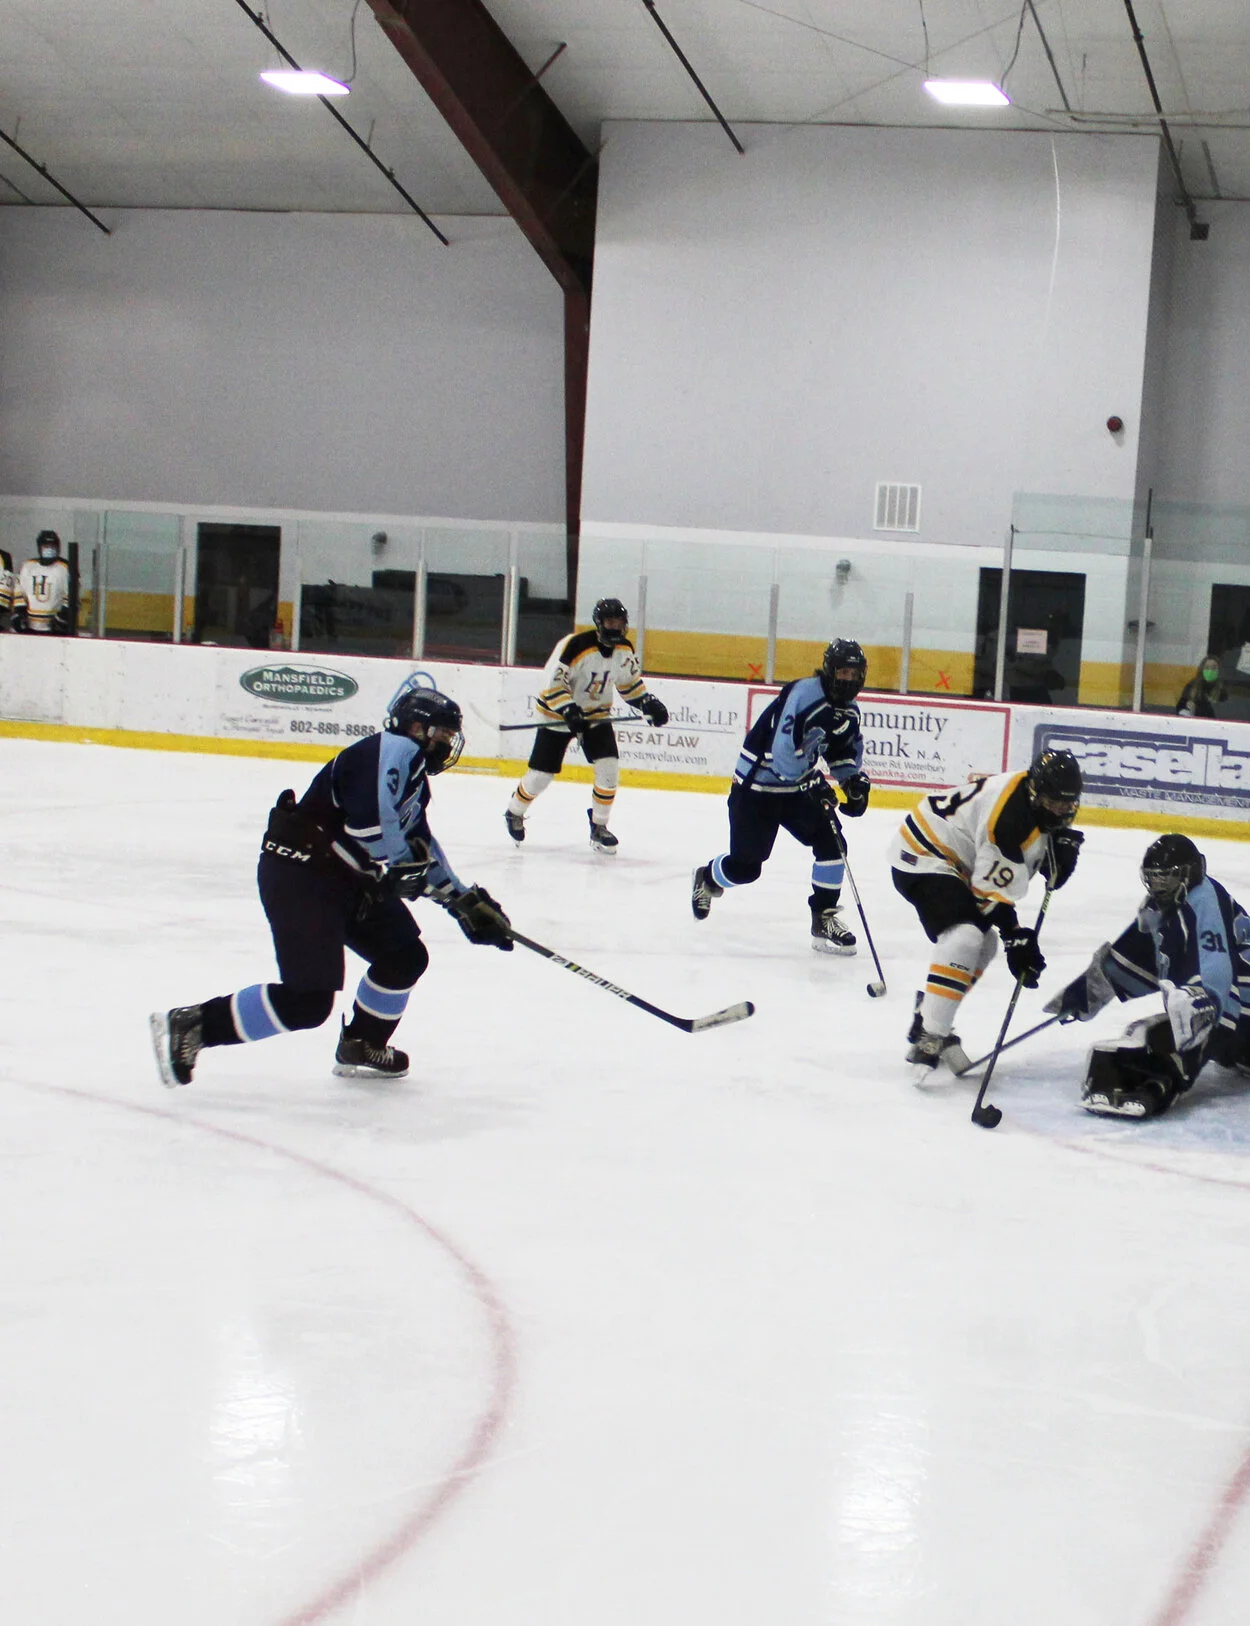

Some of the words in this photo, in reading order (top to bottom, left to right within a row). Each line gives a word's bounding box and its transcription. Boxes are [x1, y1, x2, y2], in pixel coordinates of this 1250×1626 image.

[263, 671, 335, 686] MANSFIELD
[253, 681, 345, 697] ORTHOPAEDICS
[707, 710, 738, 726] LLP
[782, 715, 795, 735] 2
[863, 711, 949, 740] munity
[646, 732, 664, 745] AT
[668, 733, 700, 748] LAW
[865, 734, 911, 758] ank
[386, 768, 401, 796] 3
[800, 777, 821, 792] CM
[1119, 787, 1160, 801] WASTE
[265, 840, 312, 862] CCM
[983, 860, 1015, 889] 19
[1004, 938, 1029, 948] CM
[1200, 930, 1228, 954] 31
